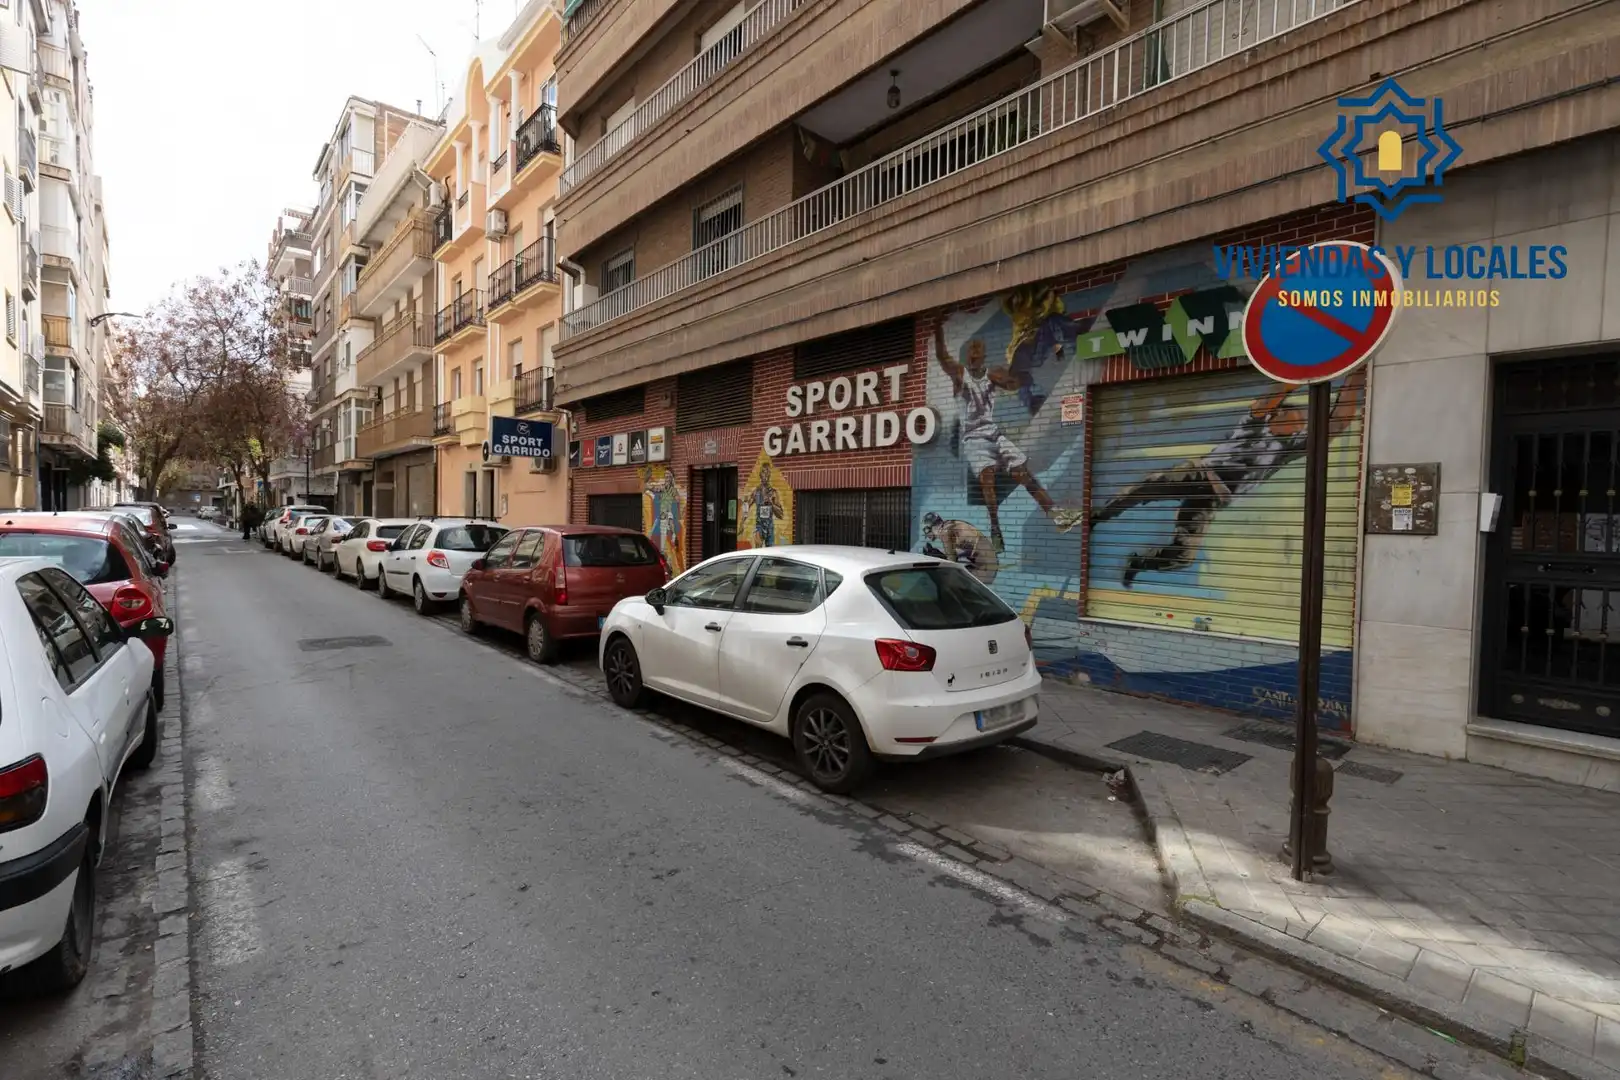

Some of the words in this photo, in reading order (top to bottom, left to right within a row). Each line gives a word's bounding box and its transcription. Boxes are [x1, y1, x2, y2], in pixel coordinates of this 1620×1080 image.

[784, 364, 909, 418] SPORT
[502, 434, 543, 447] SPORT
[763, 407, 937, 457] GARRIDO
[494, 444, 550, 457] GARRIDO
